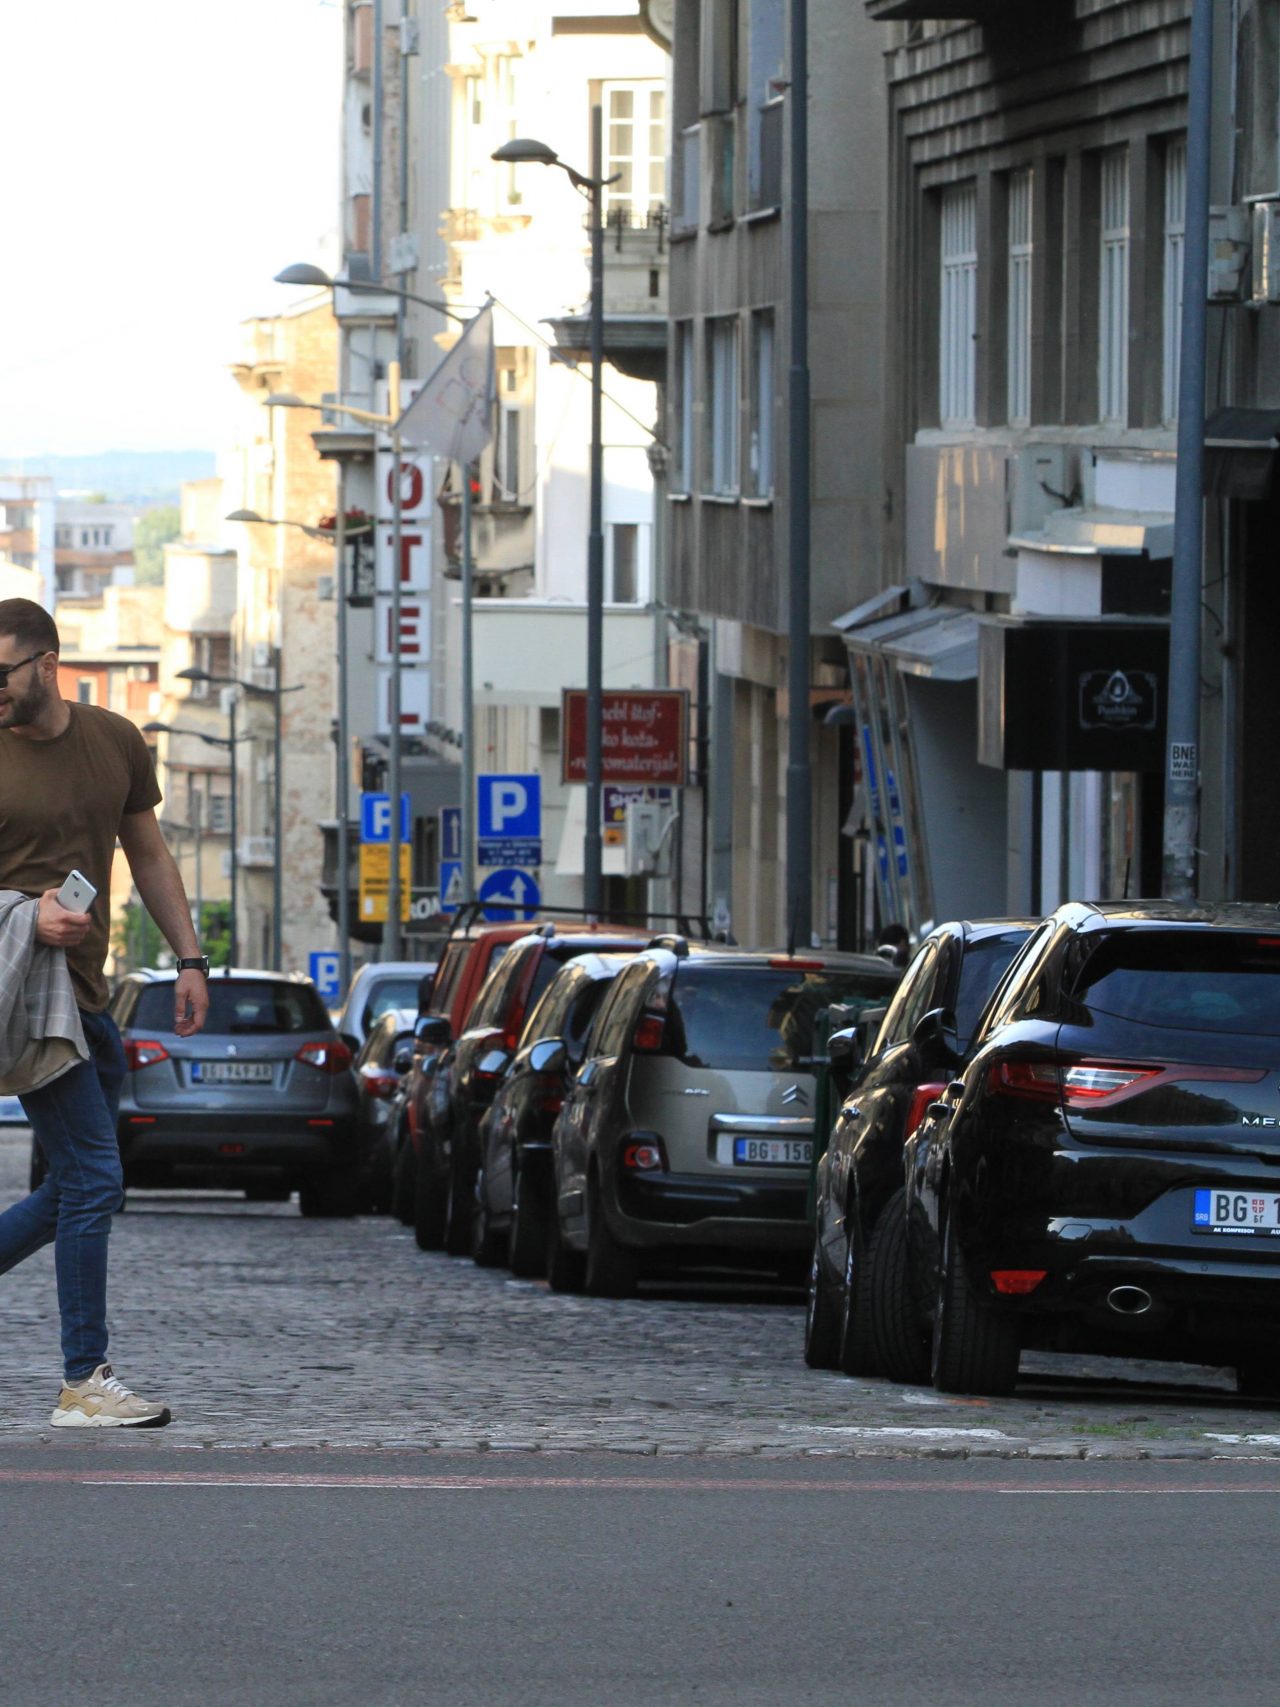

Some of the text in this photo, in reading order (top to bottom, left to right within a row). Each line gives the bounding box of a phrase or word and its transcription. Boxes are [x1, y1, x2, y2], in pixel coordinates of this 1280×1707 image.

[386, 388, 424, 724] OTEL
[1172, 745, 1196, 760] BNE
[373, 801, 394, 835] P
[491, 781, 527, 831] P
[317, 956, 339, 992] P
[1242, 1116, 1280, 1126] ME
[749, 1142, 768, 1159] BG
[1195, 1213, 1208, 1221] SRB
[1216, 1194, 1247, 1222] BG
